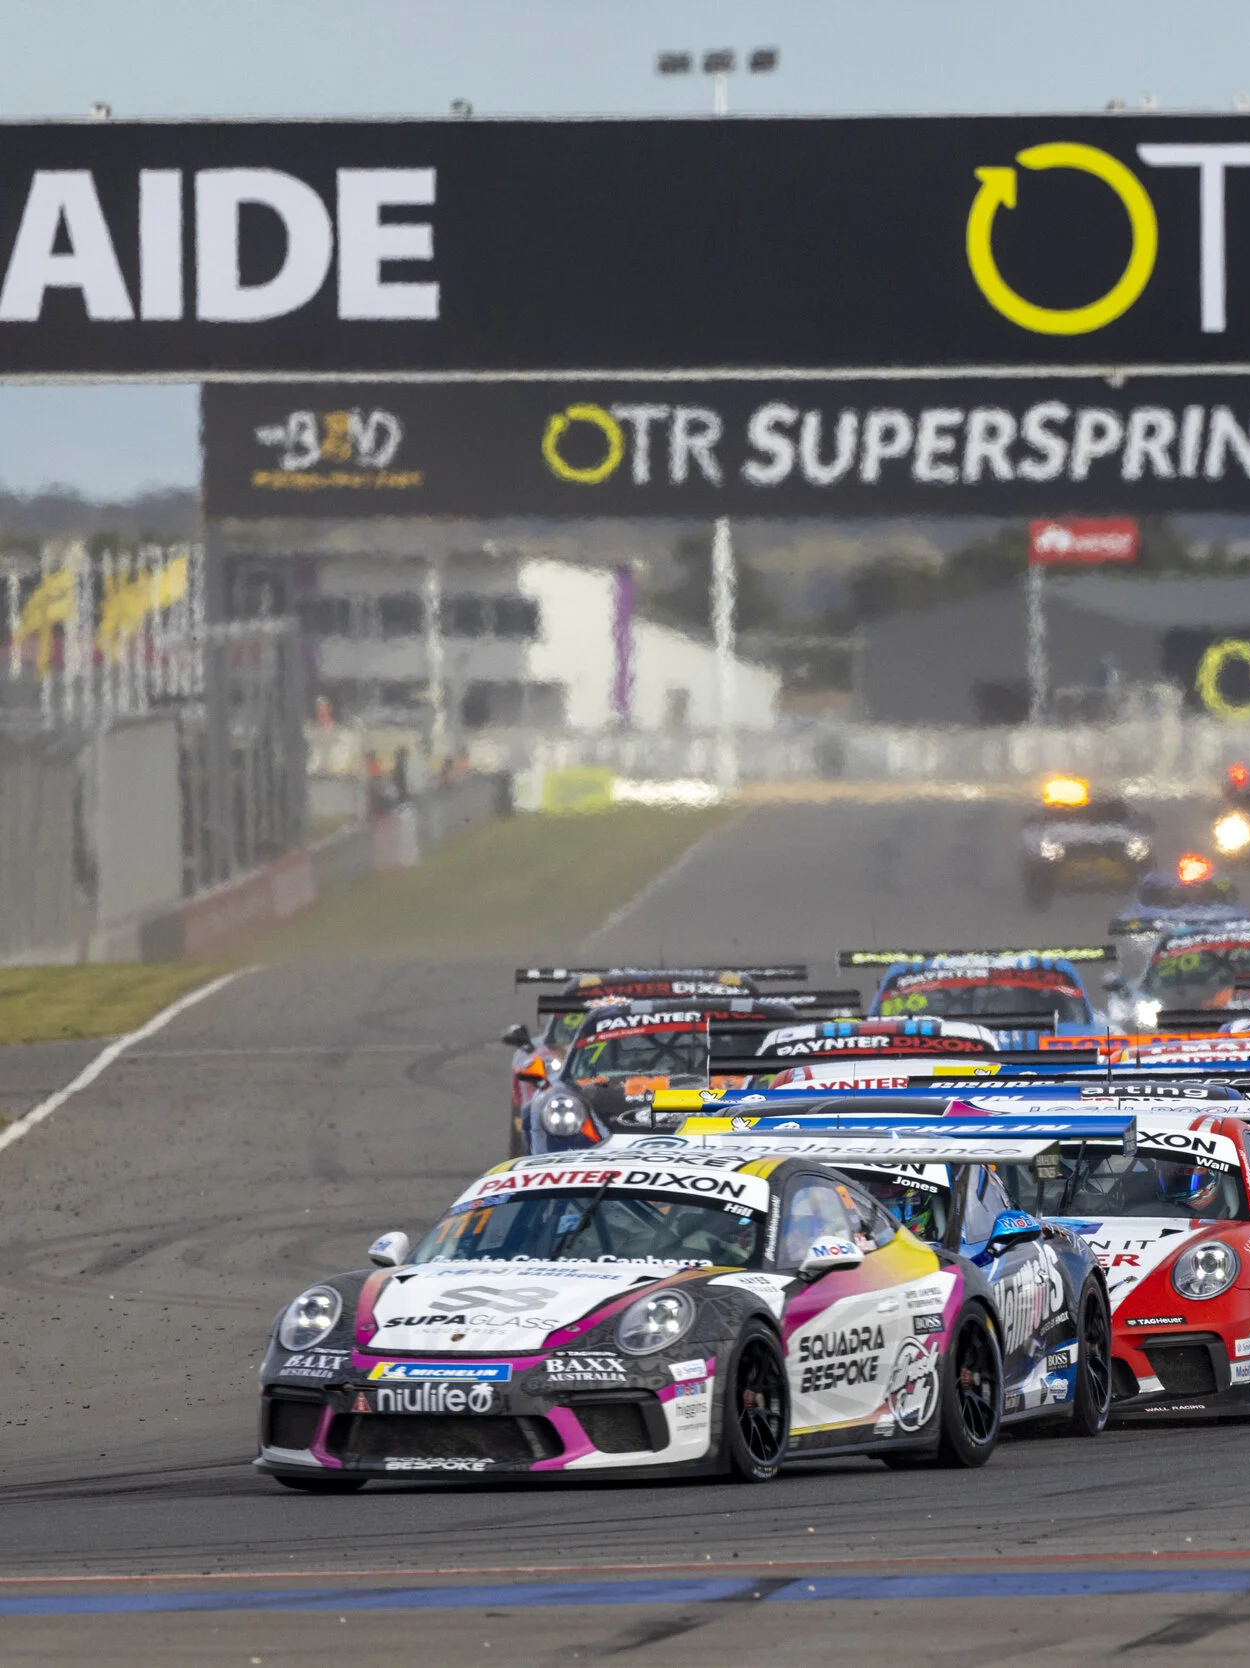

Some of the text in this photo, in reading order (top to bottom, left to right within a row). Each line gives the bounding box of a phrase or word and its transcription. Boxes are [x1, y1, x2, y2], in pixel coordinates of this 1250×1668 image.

[541, 403, 724, 486] OTR
[595, 1011, 702, 1033] PAYNTER
[776, 1035, 984, 1057] PAYNTER DIXON
[806, 1076, 908, 1089] AYNTER
[1081, 1085, 1208, 1098] arting
[1138, 1131, 1217, 1155] XON
[1196, 1156, 1229, 1172] Wall
[478, 1170, 747, 1200] PAYNTER DIXON
[892, 1176, 939, 1194] Jones
[723, 1202, 753, 1217] Hill
[999, 1217, 1038, 1228] Mobi
[383, 1313, 562, 1332] SUPAGLASS
[799, 1324, 885, 1364] SQUADRA
[284, 1354, 350, 1370] BAXX
[545, 1358, 627, 1373] BAXX
[407, 1368, 499, 1378] MICHELIN
[546, 1372, 627, 1382] AUSTRALIA
[801, 1355, 880, 1394] BESPOKE
[377, 1382, 468, 1412] niulife
[1173, 1404, 1206, 1412] RACING
[385, 1461, 488, 1472] BESPOKE
